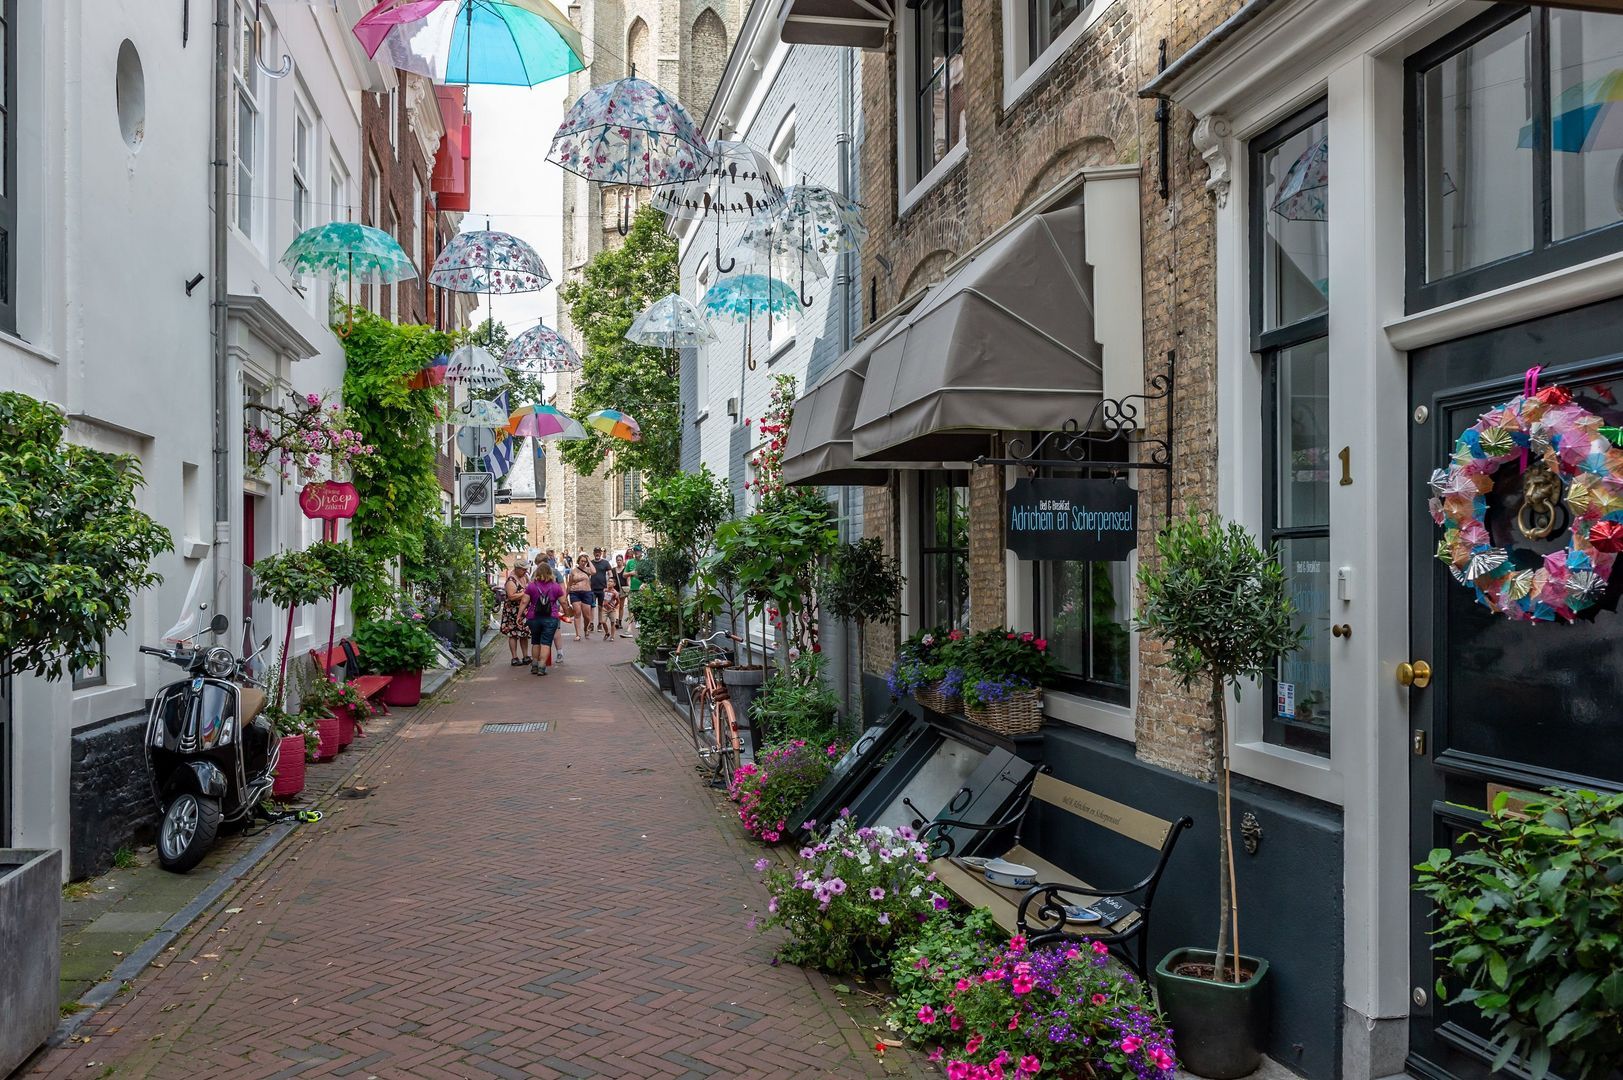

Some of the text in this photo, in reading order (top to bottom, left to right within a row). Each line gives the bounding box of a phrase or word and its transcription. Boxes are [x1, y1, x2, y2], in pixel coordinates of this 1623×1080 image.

[1338, 446, 1353, 486] 1
[1011, 505, 1133, 542] Adrichem en Scherpenseel
